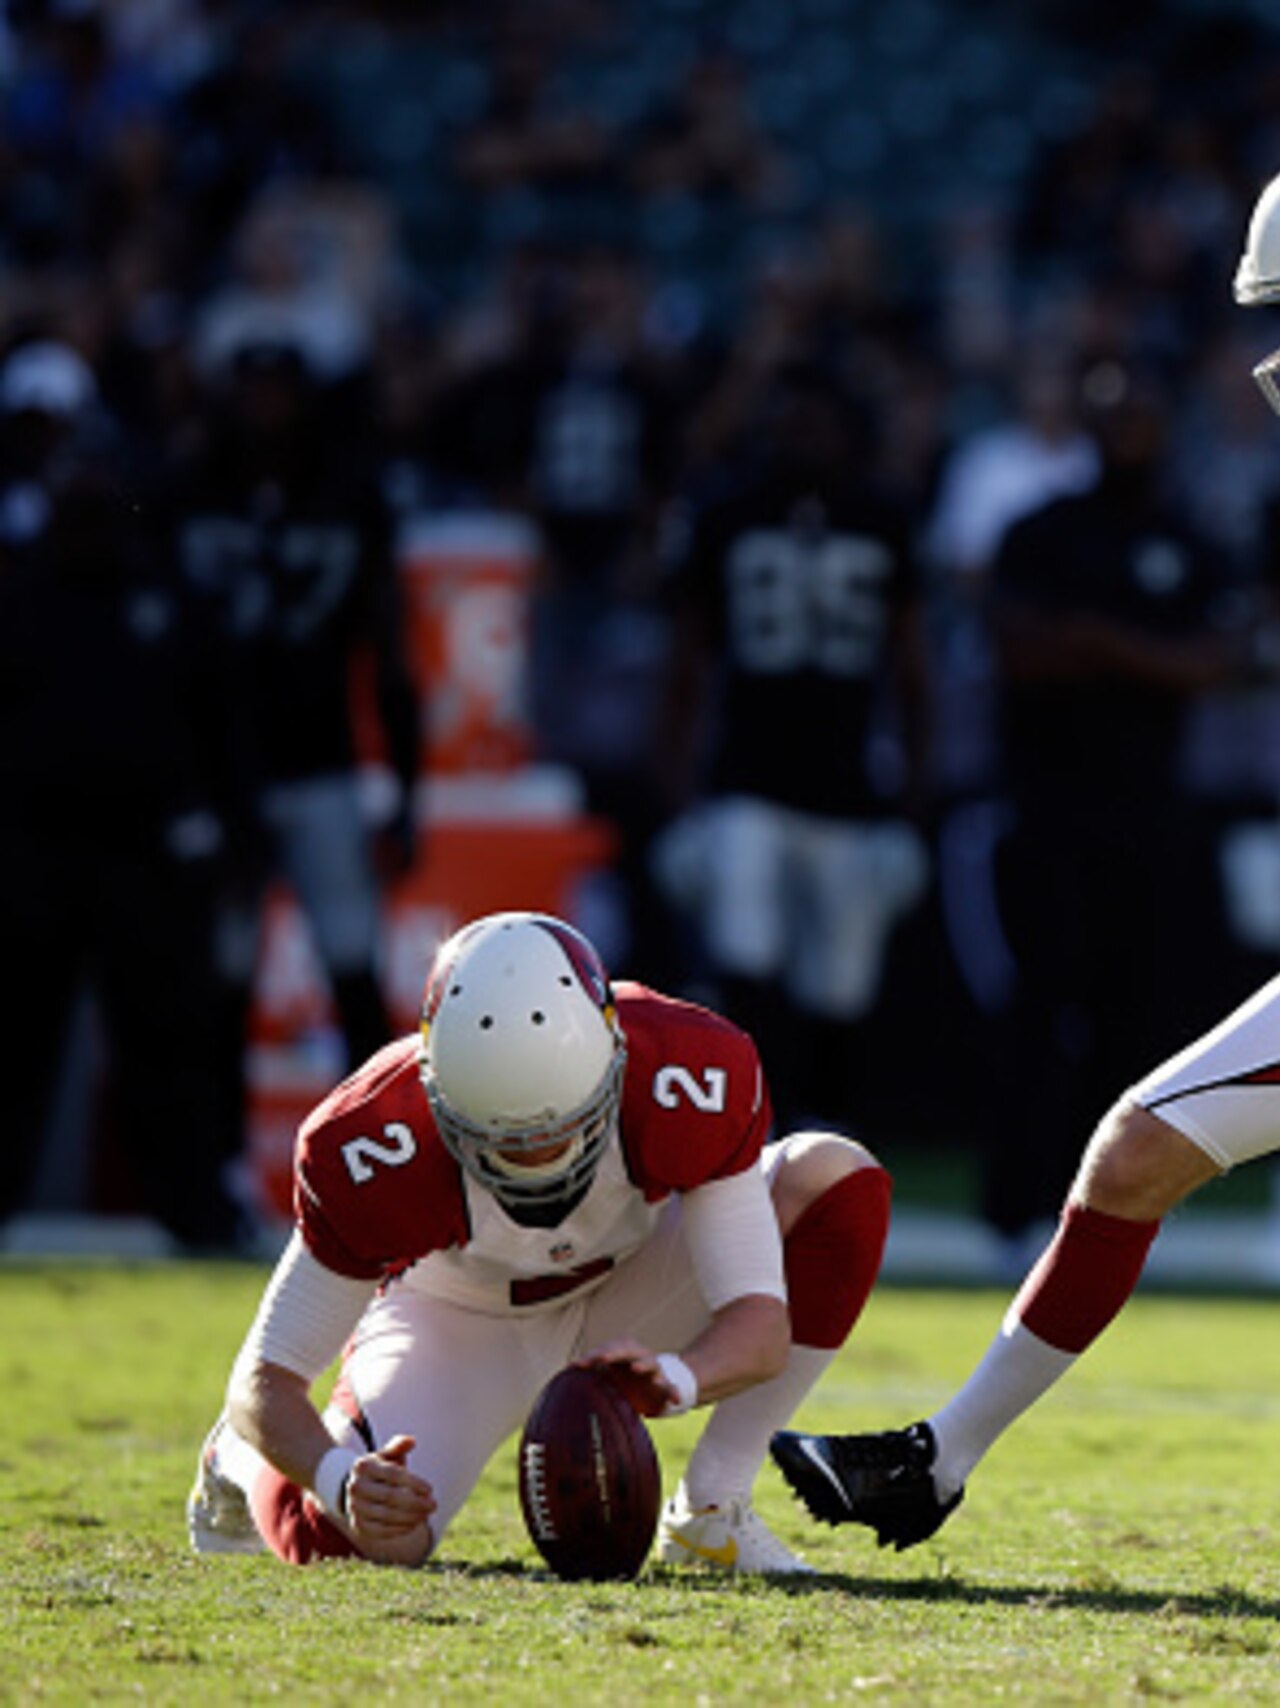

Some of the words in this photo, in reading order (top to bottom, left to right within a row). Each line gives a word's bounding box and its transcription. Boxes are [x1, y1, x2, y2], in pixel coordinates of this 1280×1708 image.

[177, 512, 363, 645] 57
[726, 526, 895, 675] 85
[652, 1064, 727, 1114] 2
[340, 1122, 417, 1186] 2
